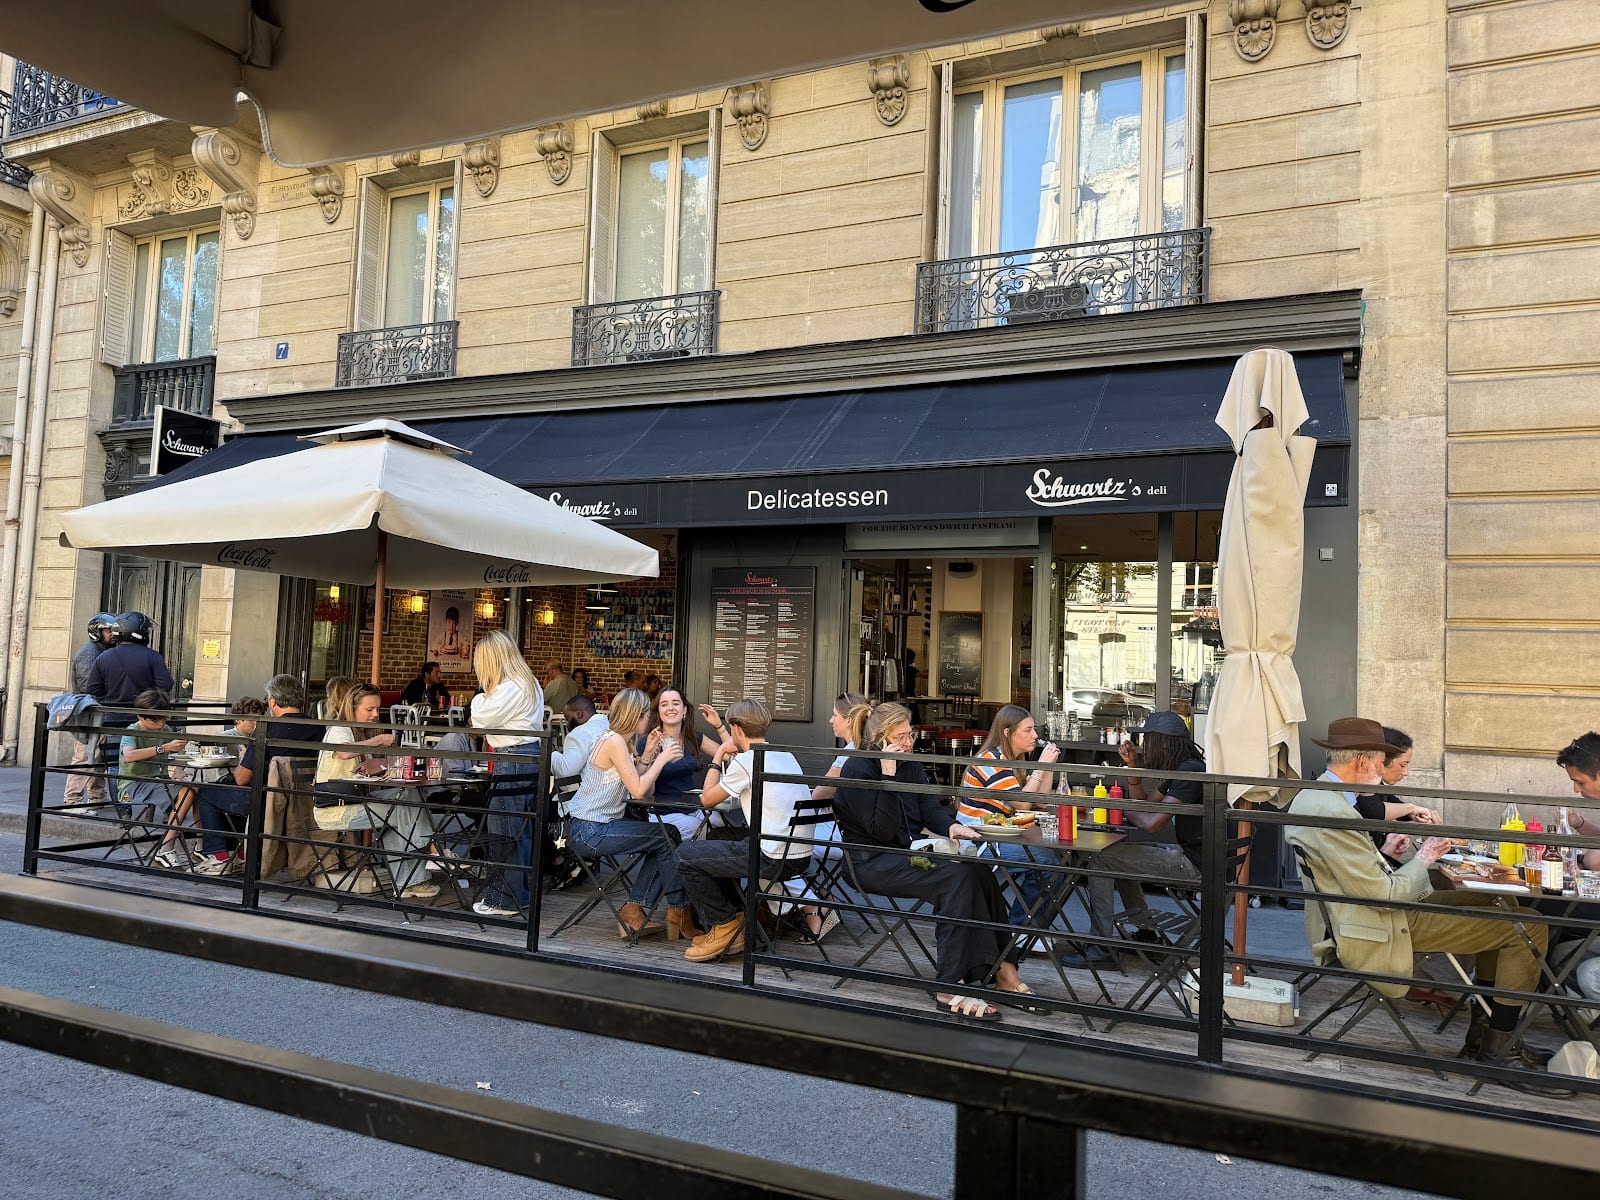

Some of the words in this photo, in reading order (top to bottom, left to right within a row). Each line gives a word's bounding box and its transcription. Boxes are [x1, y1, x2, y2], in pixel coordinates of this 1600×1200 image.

[278, 344, 286, 359] 7
[162, 430, 213, 457] Schwartz'
[747, 488, 888, 510] Delicatessen
[1025, 468, 1142, 506] Schwartz's
[1147, 485, 1168, 495] deli
[549, 492, 621, 520] Shwartz's
[623, 508, 638, 516] deli
[217, 543, 277, 569] Coca-Cola
[484, 563, 530, 583] Coca-Cola
